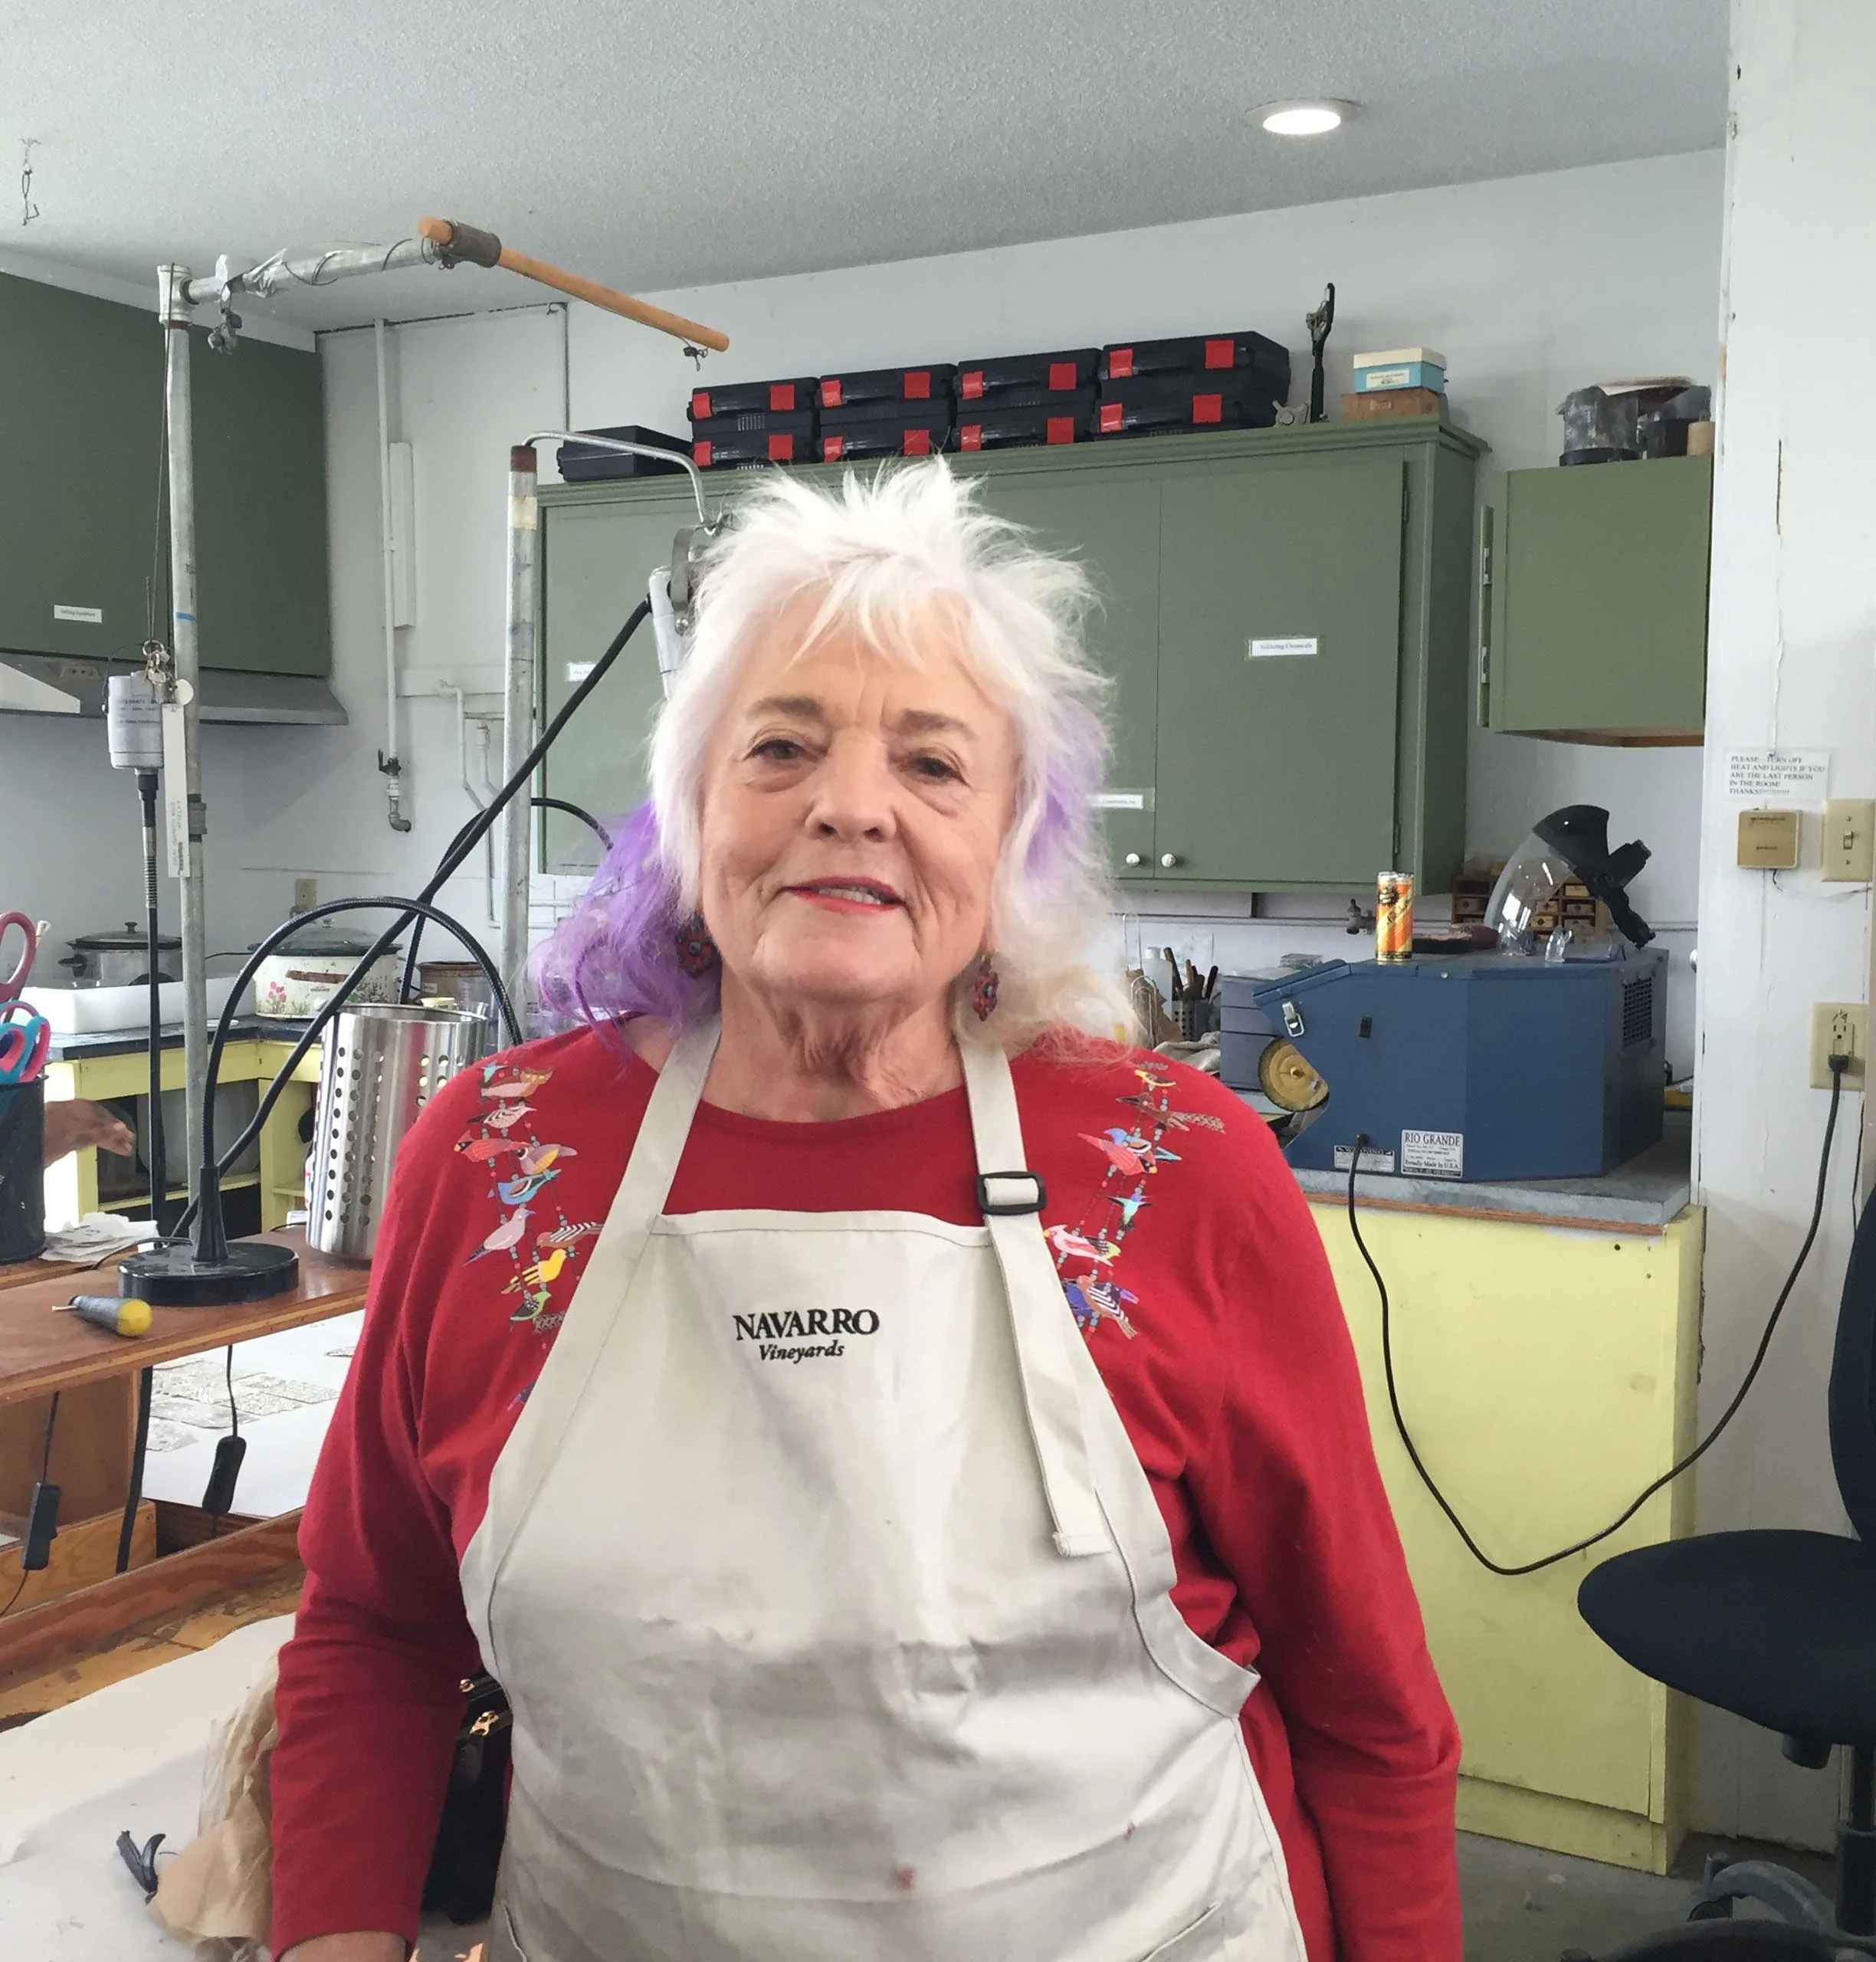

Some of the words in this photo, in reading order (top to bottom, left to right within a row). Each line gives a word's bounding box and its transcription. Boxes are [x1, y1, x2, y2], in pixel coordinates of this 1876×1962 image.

[1405, 1133, 1421, 1143] RIO
[1423, 1134, 1460, 1147] GRANDE
[1346, 1147, 1382, 1155] WRNING
[733, 1308, 881, 1341] NAVARRO
[759, 1340, 845, 1364] Vineyards
